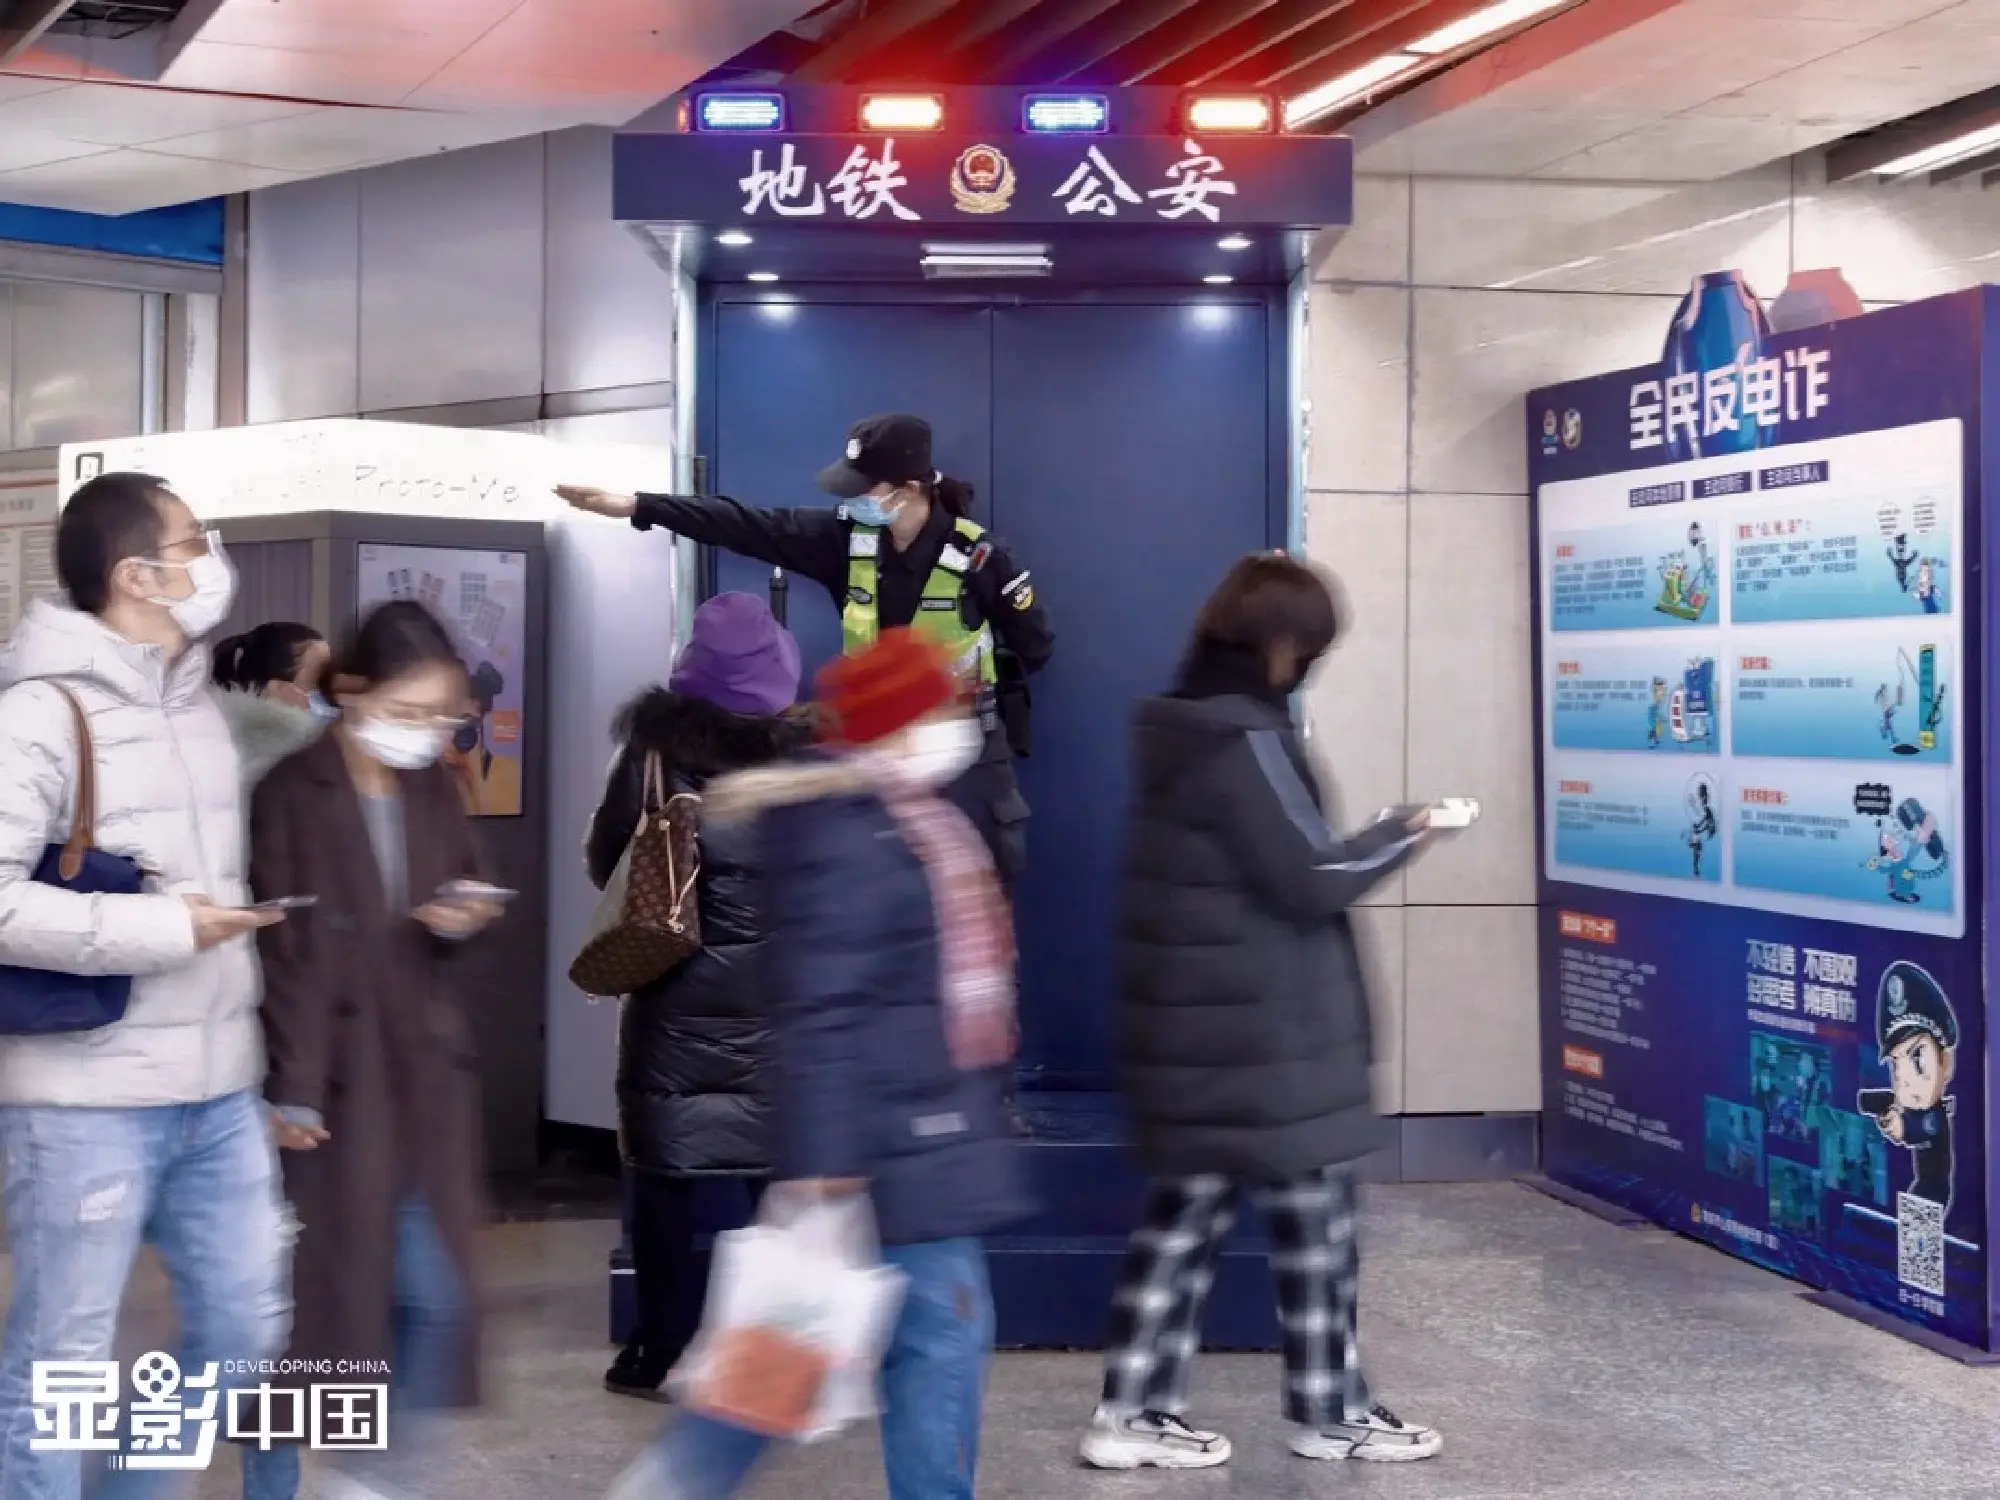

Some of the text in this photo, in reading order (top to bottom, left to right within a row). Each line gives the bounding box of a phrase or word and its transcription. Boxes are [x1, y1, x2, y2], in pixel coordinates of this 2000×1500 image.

[739, 138, 1238, 223] 地铁 公安
[1629, 343, 1831, 455] 全民反电诈
